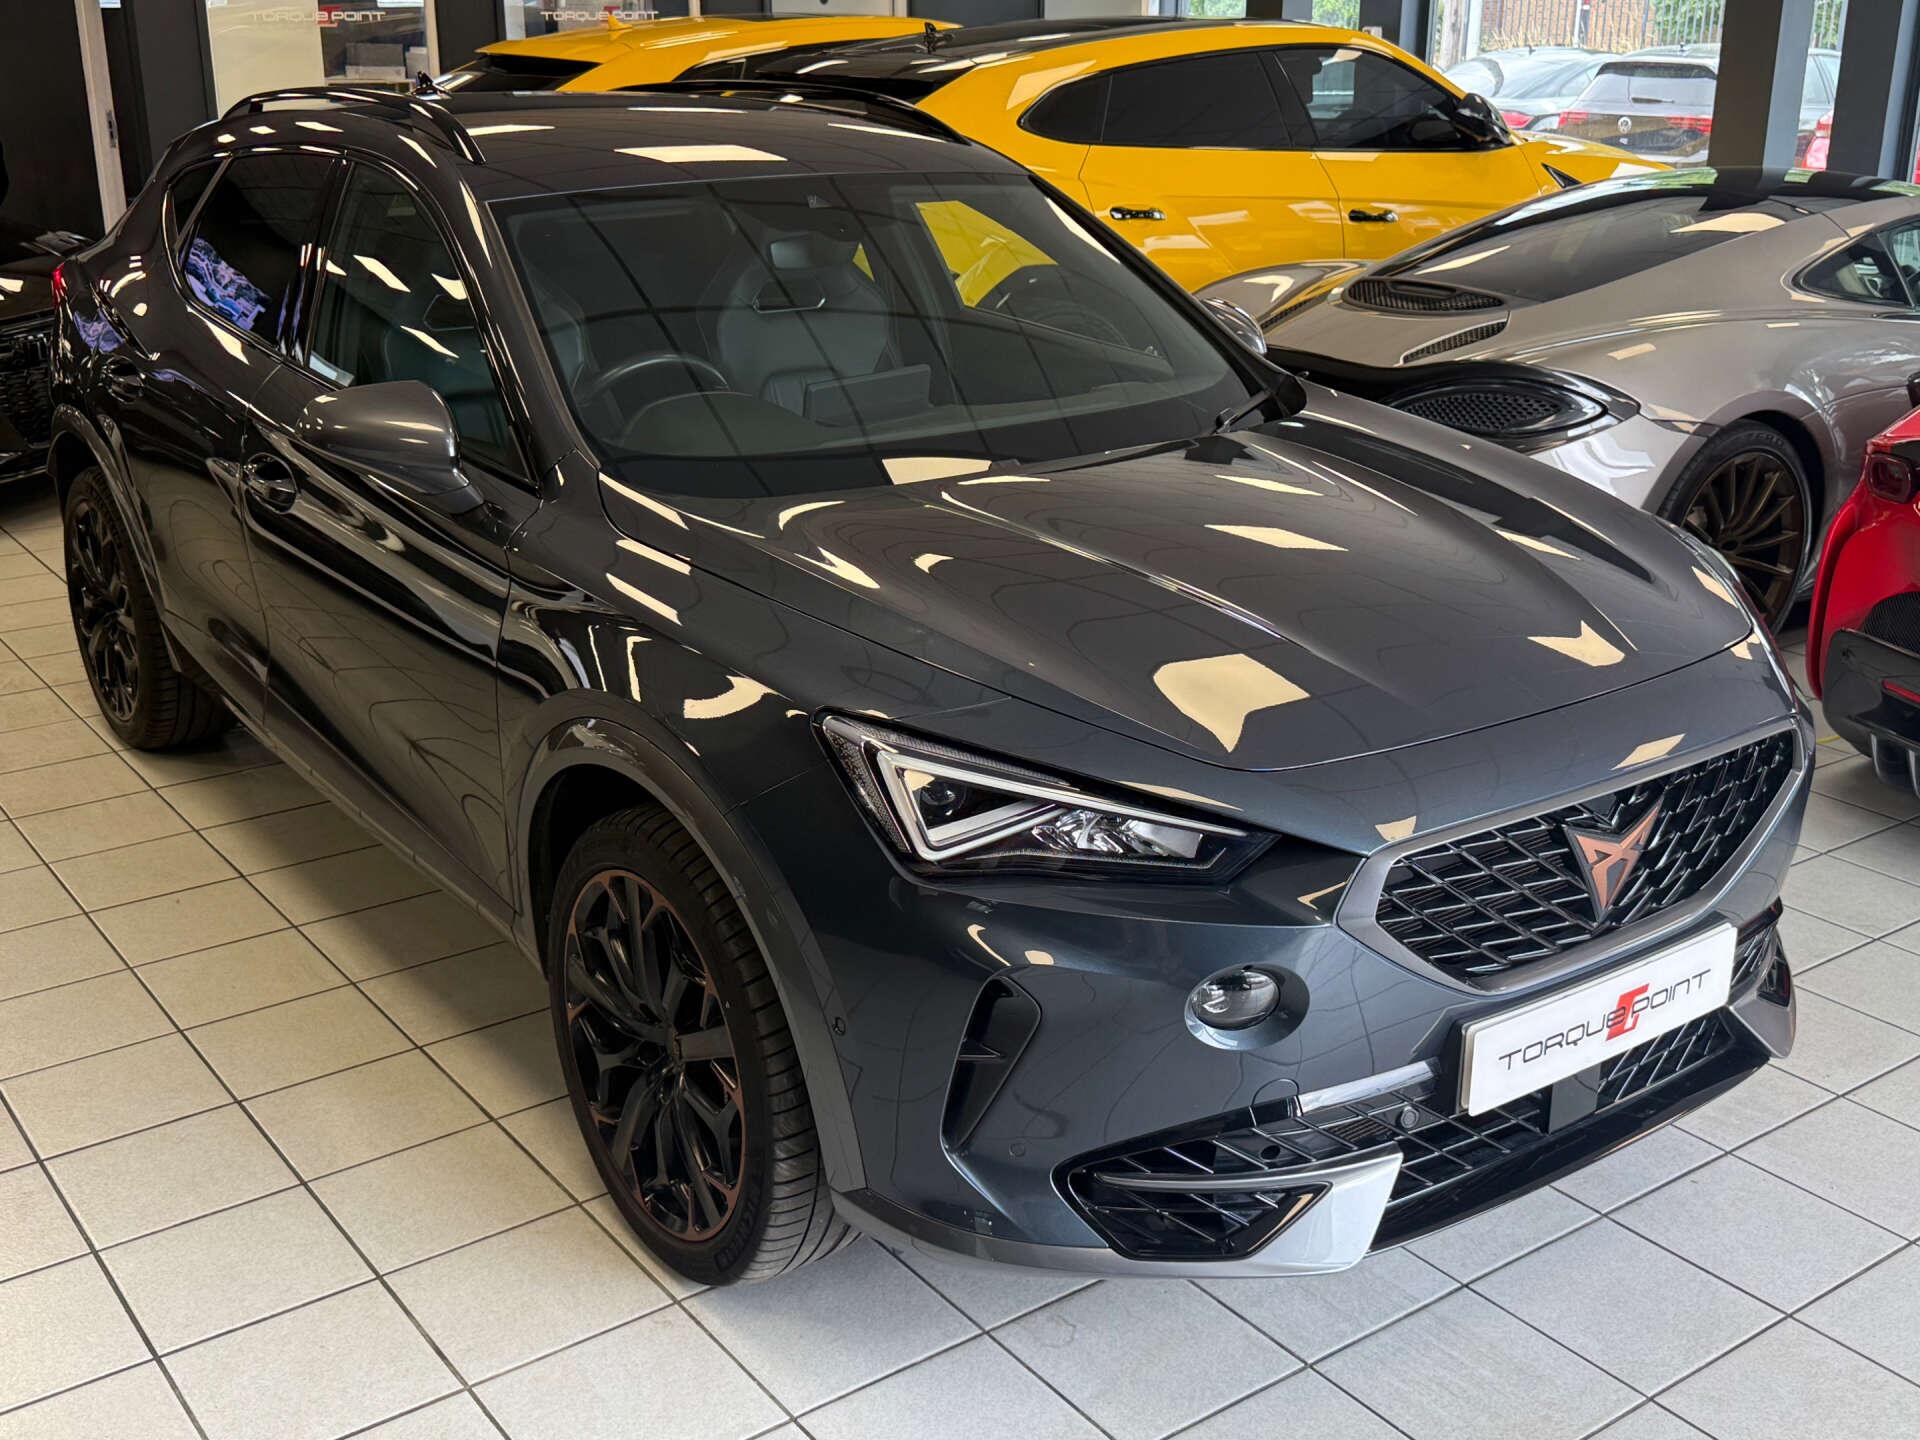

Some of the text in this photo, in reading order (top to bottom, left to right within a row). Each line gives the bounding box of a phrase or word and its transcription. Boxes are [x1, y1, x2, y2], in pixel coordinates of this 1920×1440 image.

[331, 11, 386, 21] POINT
[541, 11, 609, 22] TORQUE
[1499, 969, 1711, 1070] TORQUE POINT
